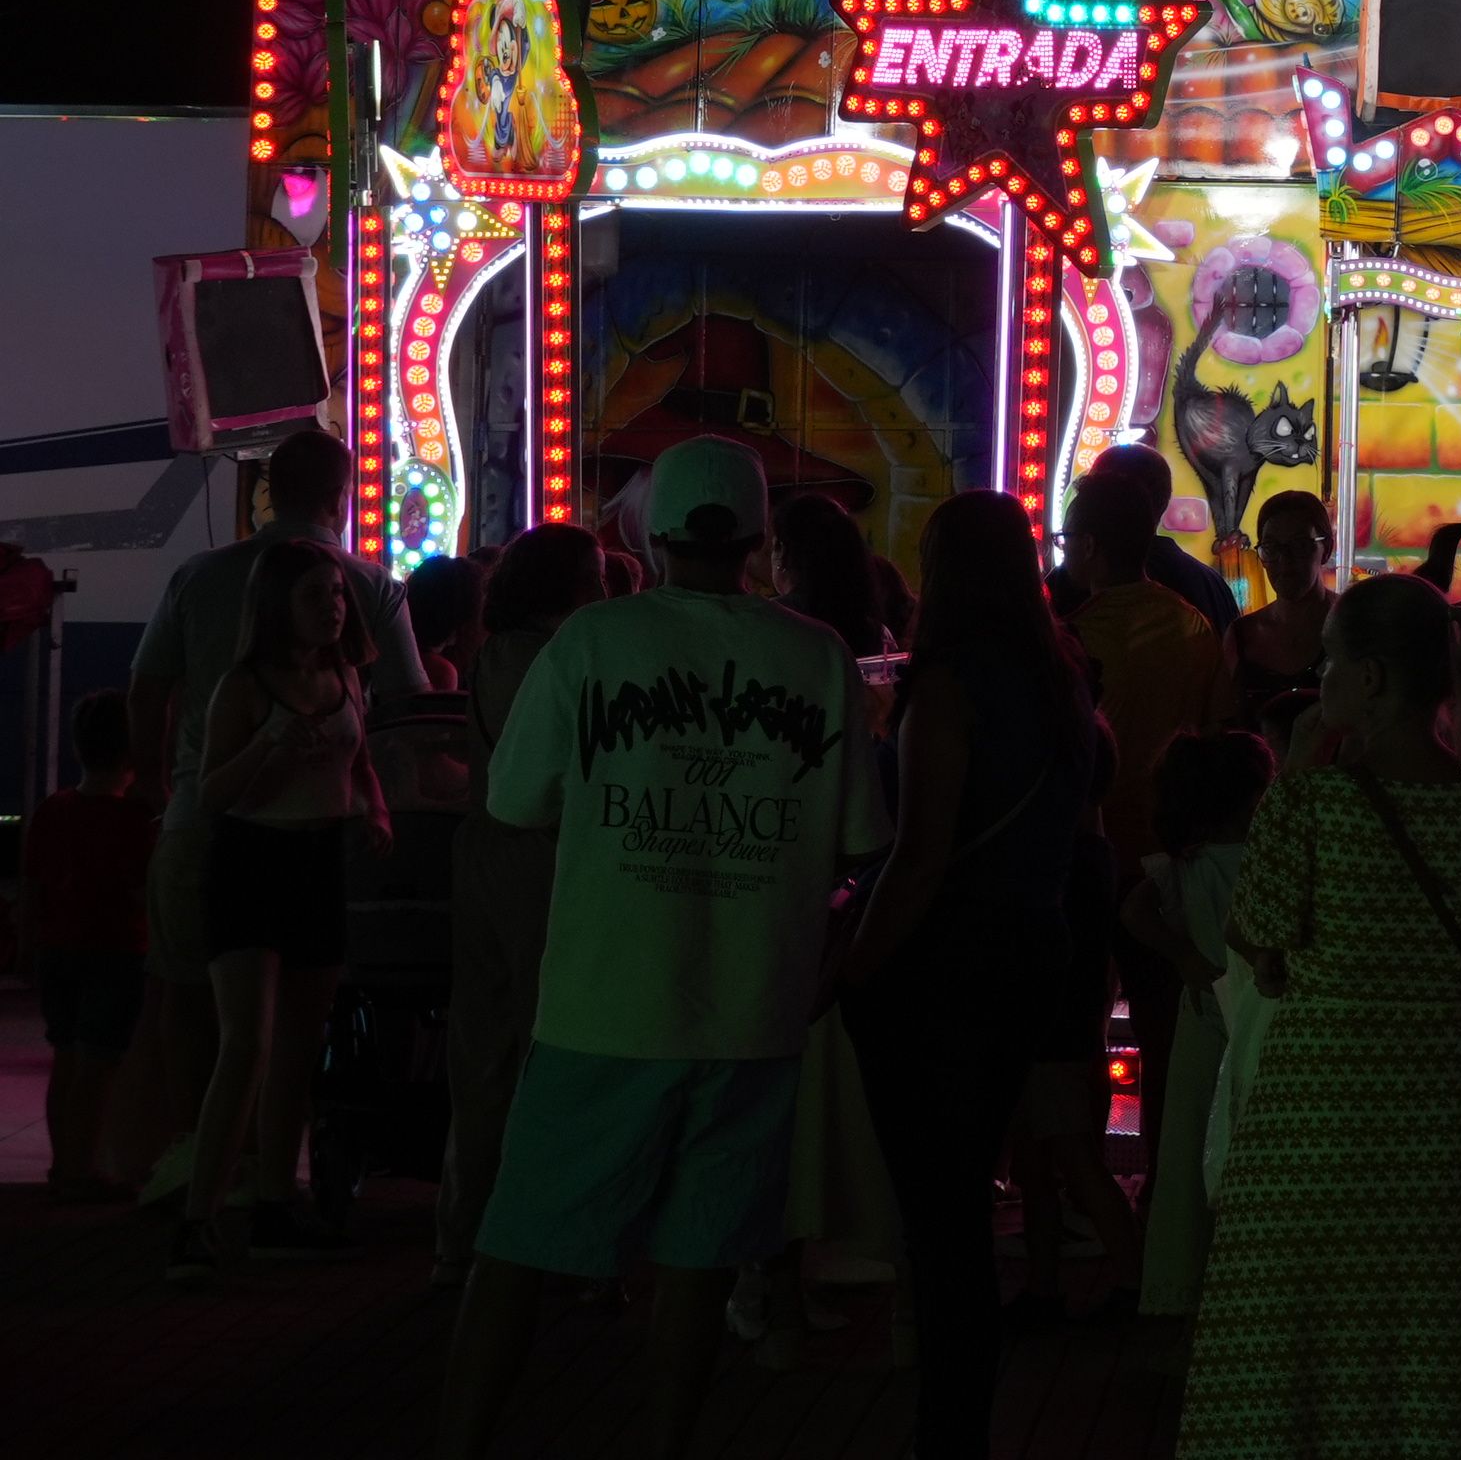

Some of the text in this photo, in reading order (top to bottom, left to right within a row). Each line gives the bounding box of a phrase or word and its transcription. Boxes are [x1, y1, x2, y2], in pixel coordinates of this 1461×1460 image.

[870, 27, 1139, 90] ENTRADA
[599, 783, 802, 842] BALANCE
[622, 819, 781, 863] Shapes Power
